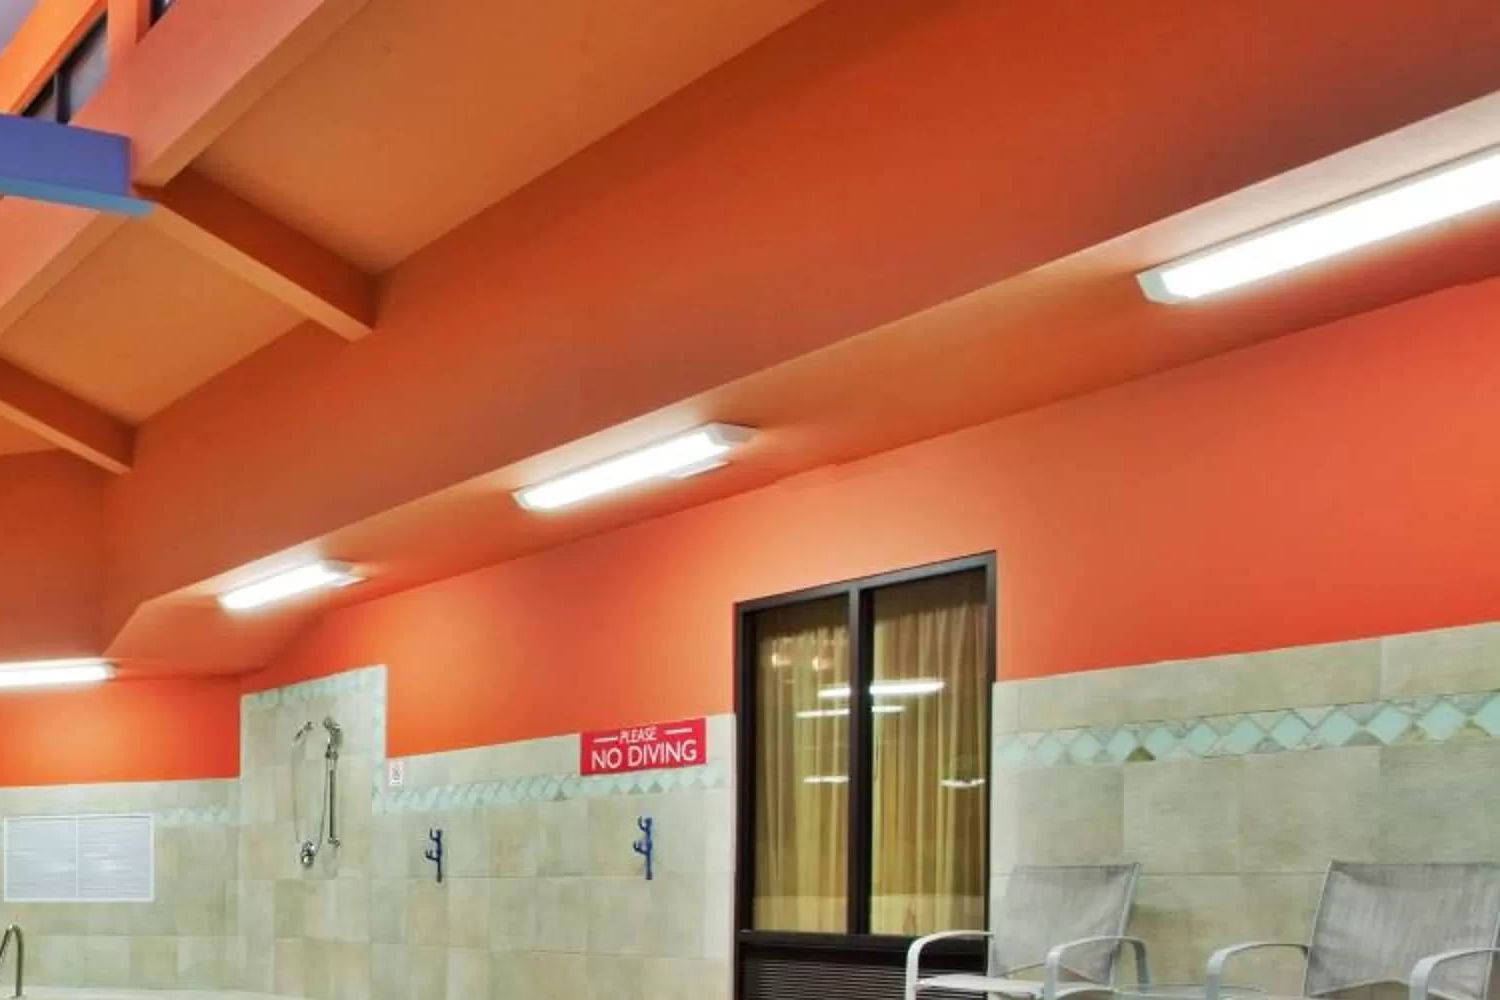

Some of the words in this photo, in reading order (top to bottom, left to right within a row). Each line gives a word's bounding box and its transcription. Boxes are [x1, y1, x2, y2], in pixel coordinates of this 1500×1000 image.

[619, 727, 657, 744] PLEASE
[591, 747, 622, 770] NO
[627, 739, 697, 767] DIVING
